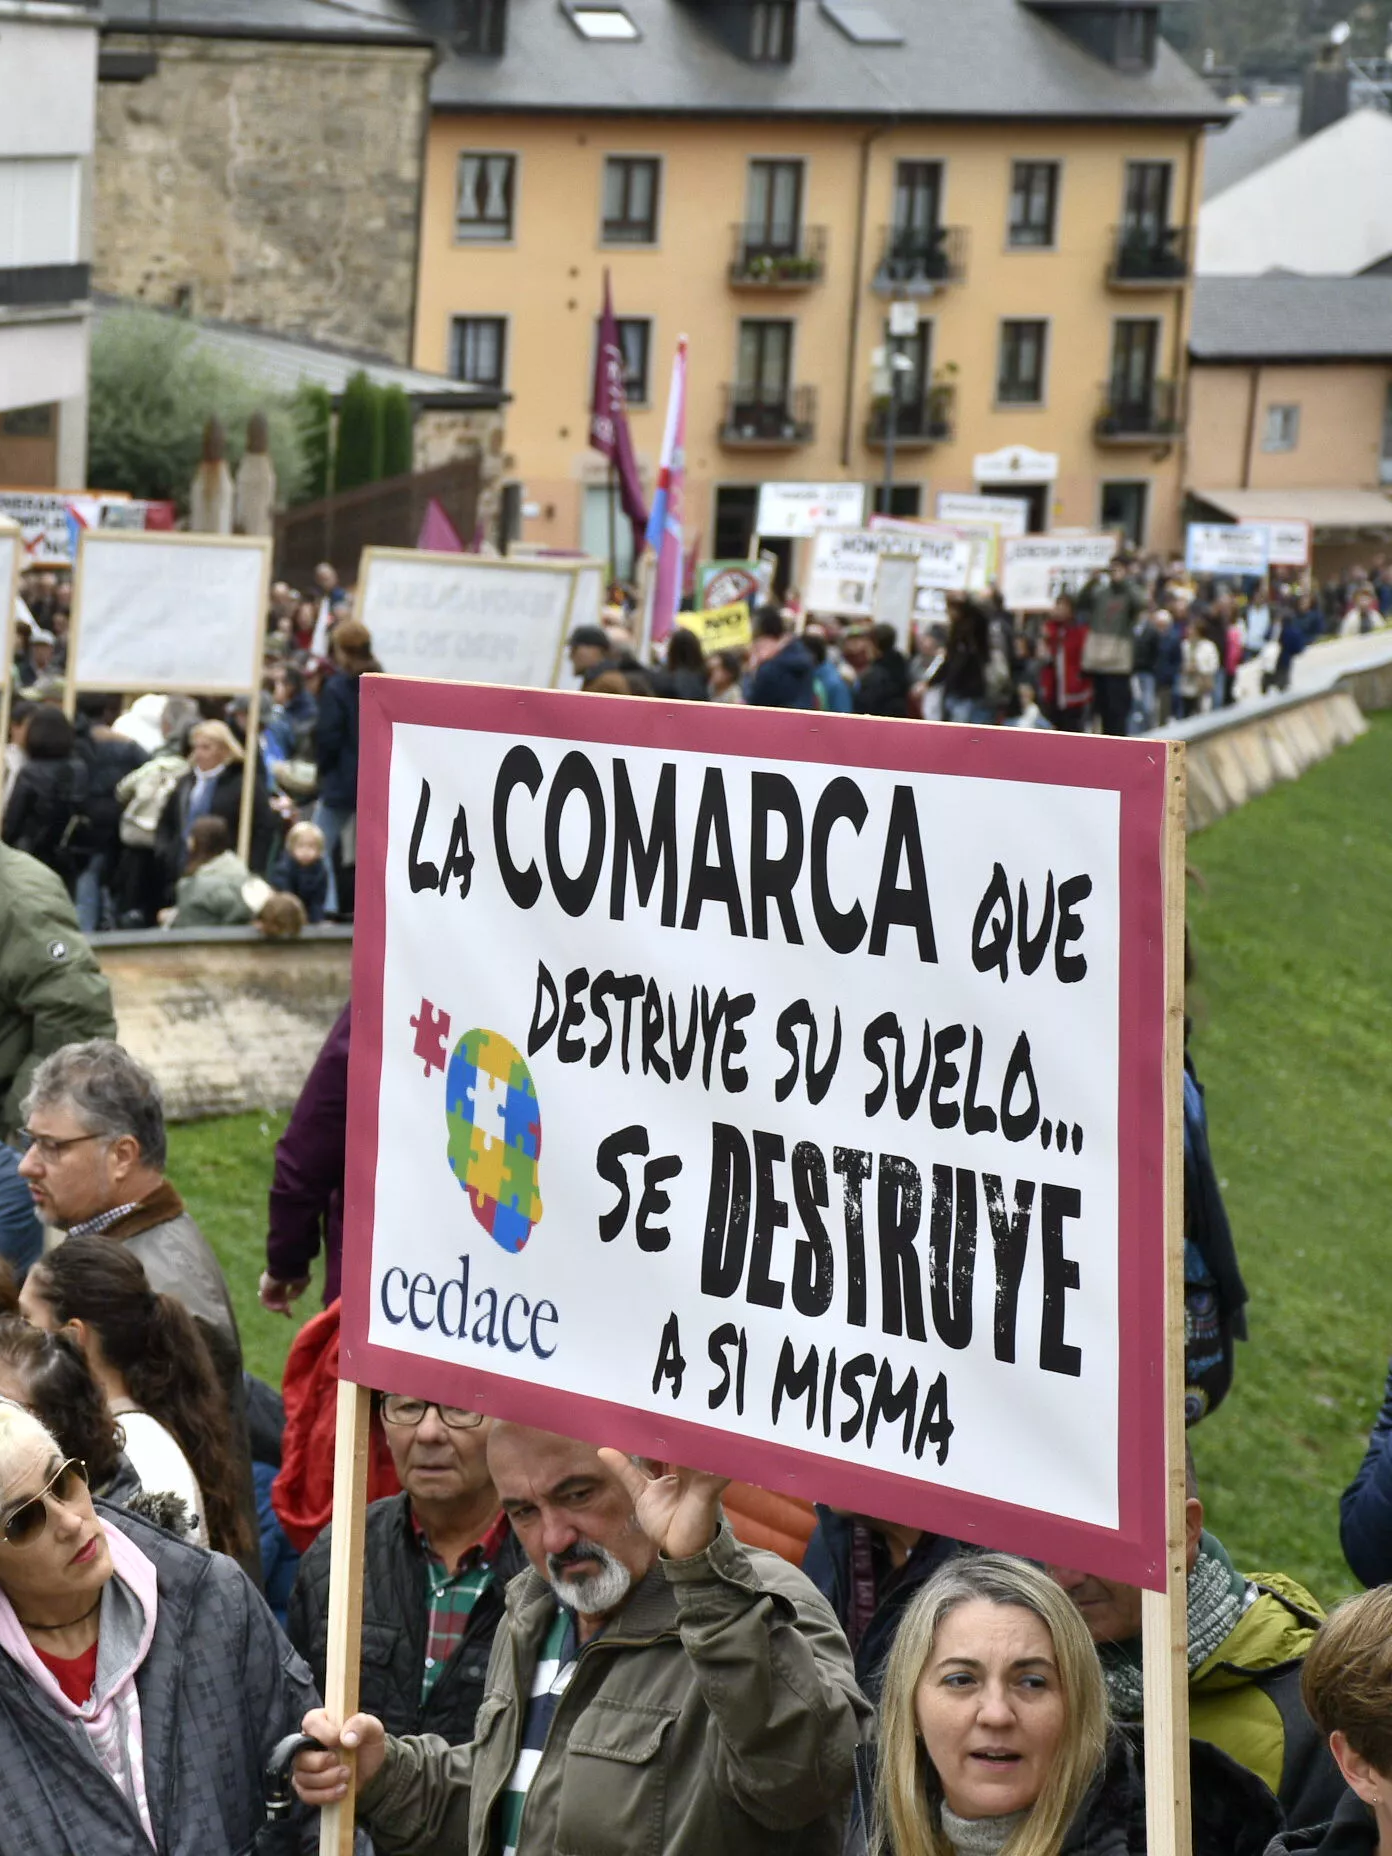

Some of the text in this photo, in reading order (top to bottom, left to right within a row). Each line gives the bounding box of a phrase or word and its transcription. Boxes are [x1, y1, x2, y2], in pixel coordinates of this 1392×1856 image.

[408, 744, 1093, 984] LA COMARCA QUE
[527, 959, 1085, 1155] DESTRUYE SU SUELO...
[380, 1254, 560, 1361] cedace
[596, 1121, 1082, 1378] SE DESTRUYE
[651, 1311, 955, 1467] A SI MISMA
